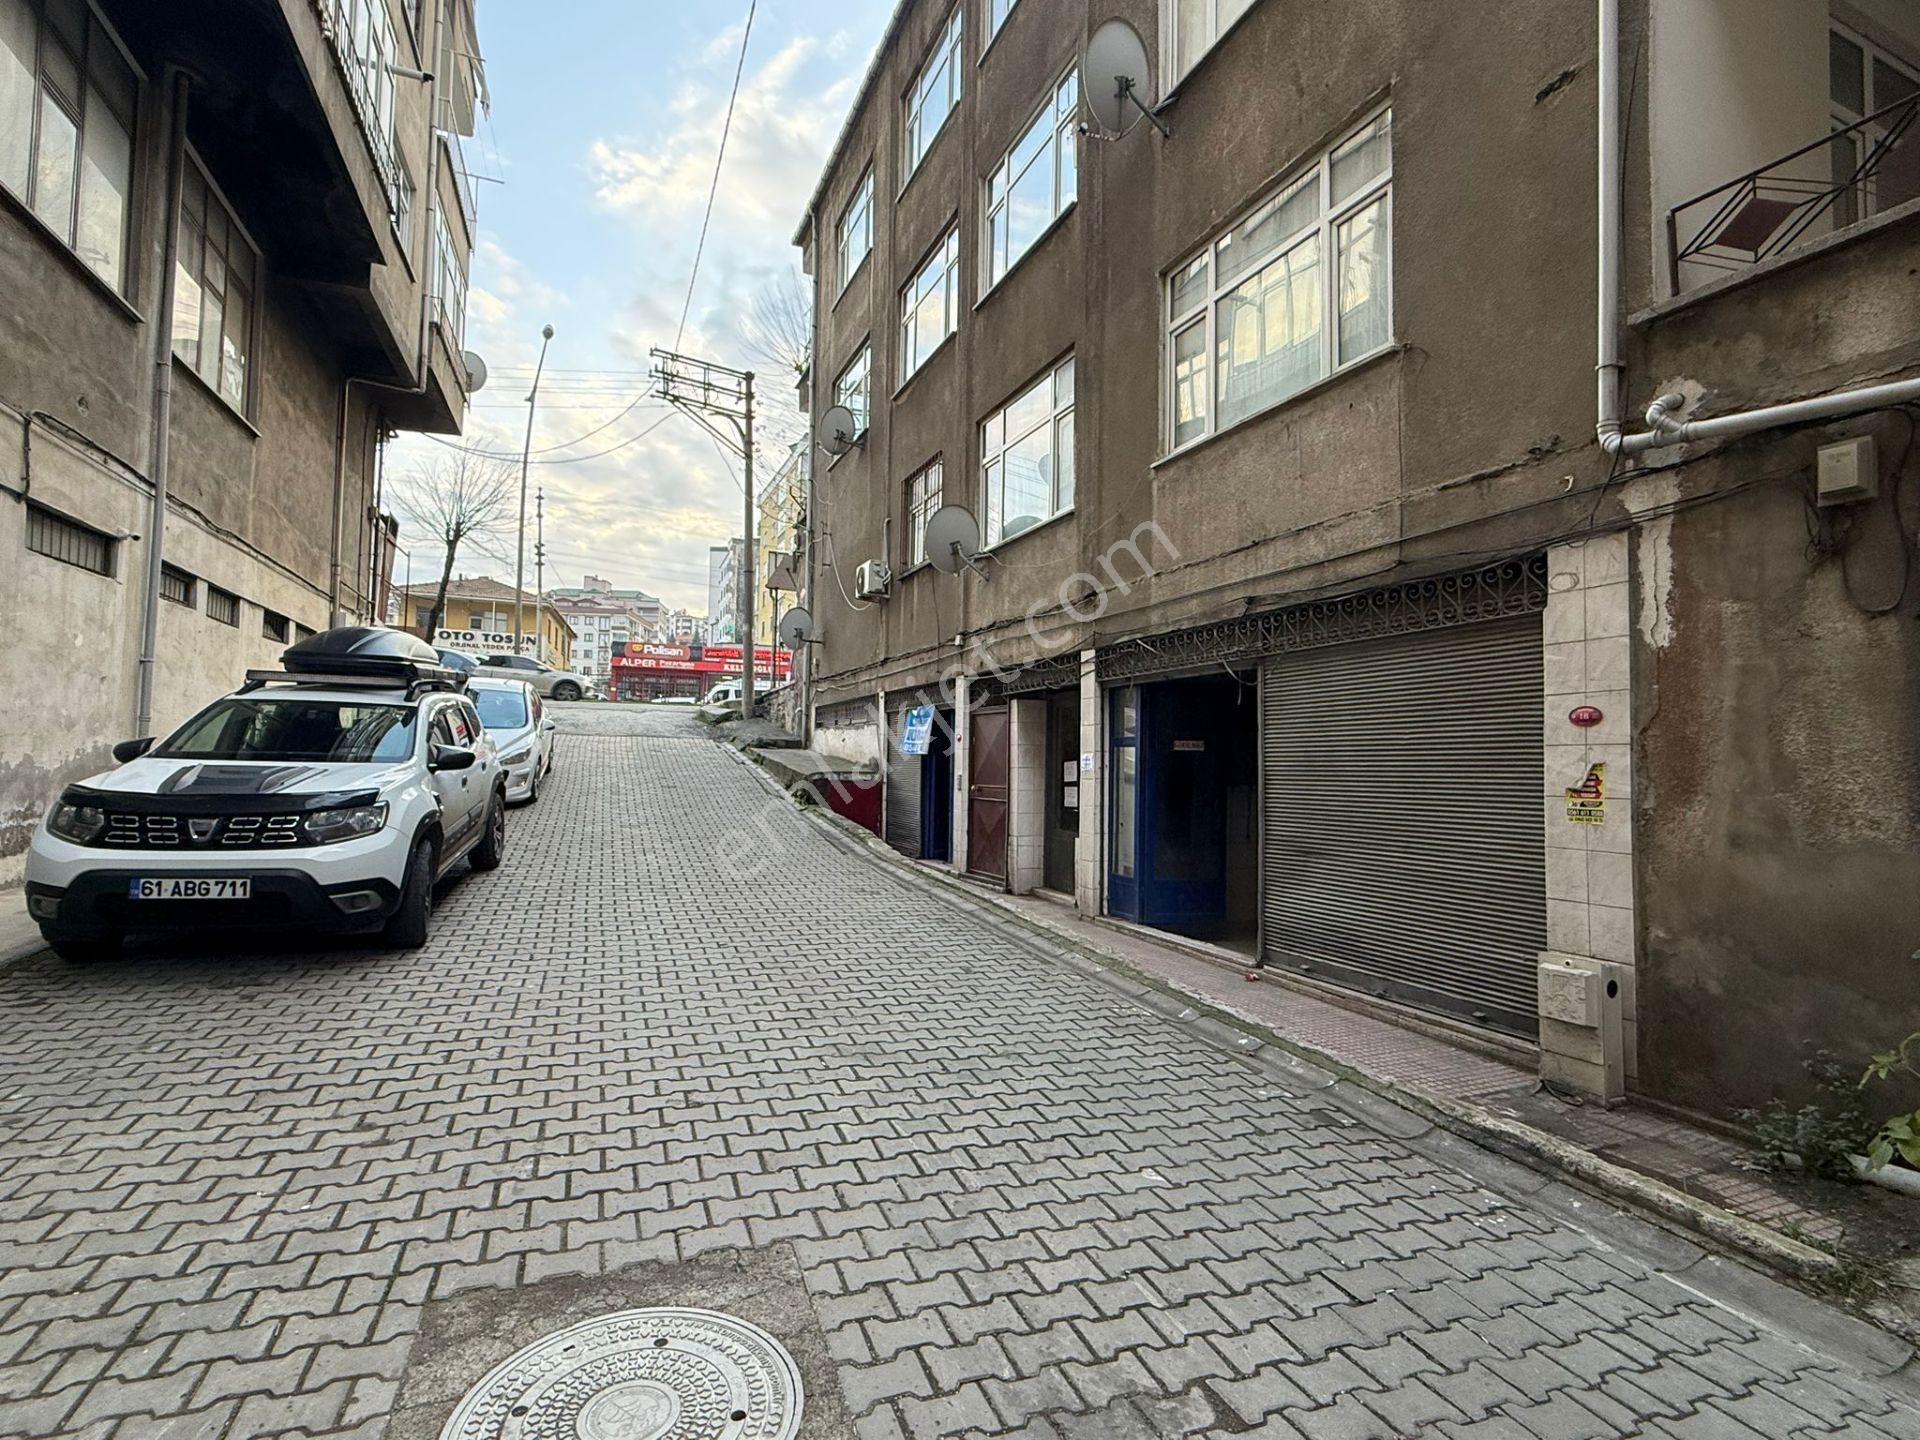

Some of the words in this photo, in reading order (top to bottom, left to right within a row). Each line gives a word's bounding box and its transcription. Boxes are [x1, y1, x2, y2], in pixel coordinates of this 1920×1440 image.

[439, 630, 474, 641] OTO
[643, 644, 684, 657] Polisan
[620, 659, 657, 667] ALPER
[140, 880, 162, 897] 61
[170, 880, 211, 897] ABG
[214, 880, 248, 897] 711
